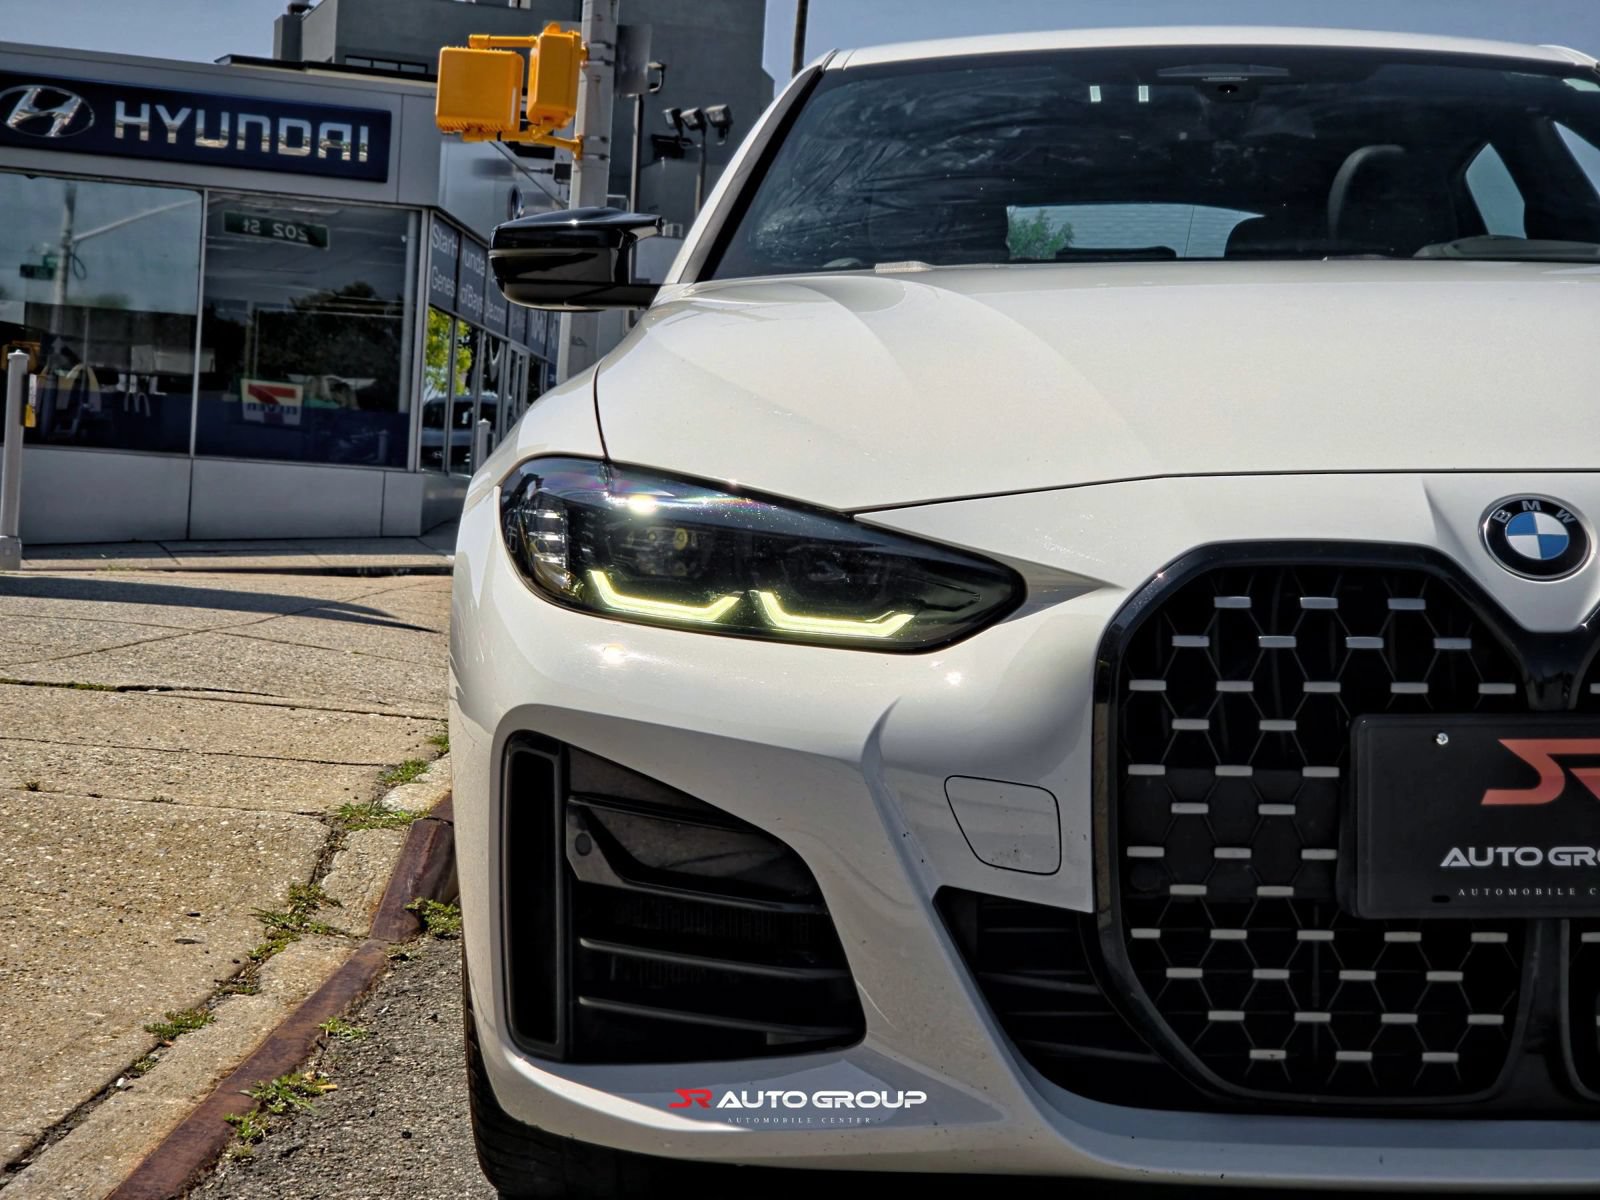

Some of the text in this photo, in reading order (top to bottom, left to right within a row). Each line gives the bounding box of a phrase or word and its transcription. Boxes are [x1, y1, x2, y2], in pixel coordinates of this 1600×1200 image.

[114, 100, 369, 162] HYUNDAI
[1493, 501, 1576, 524] BMW
[1440, 846, 1600, 867] AUTO GR
[1458, 887, 1577, 896] AUTOMOBILE
